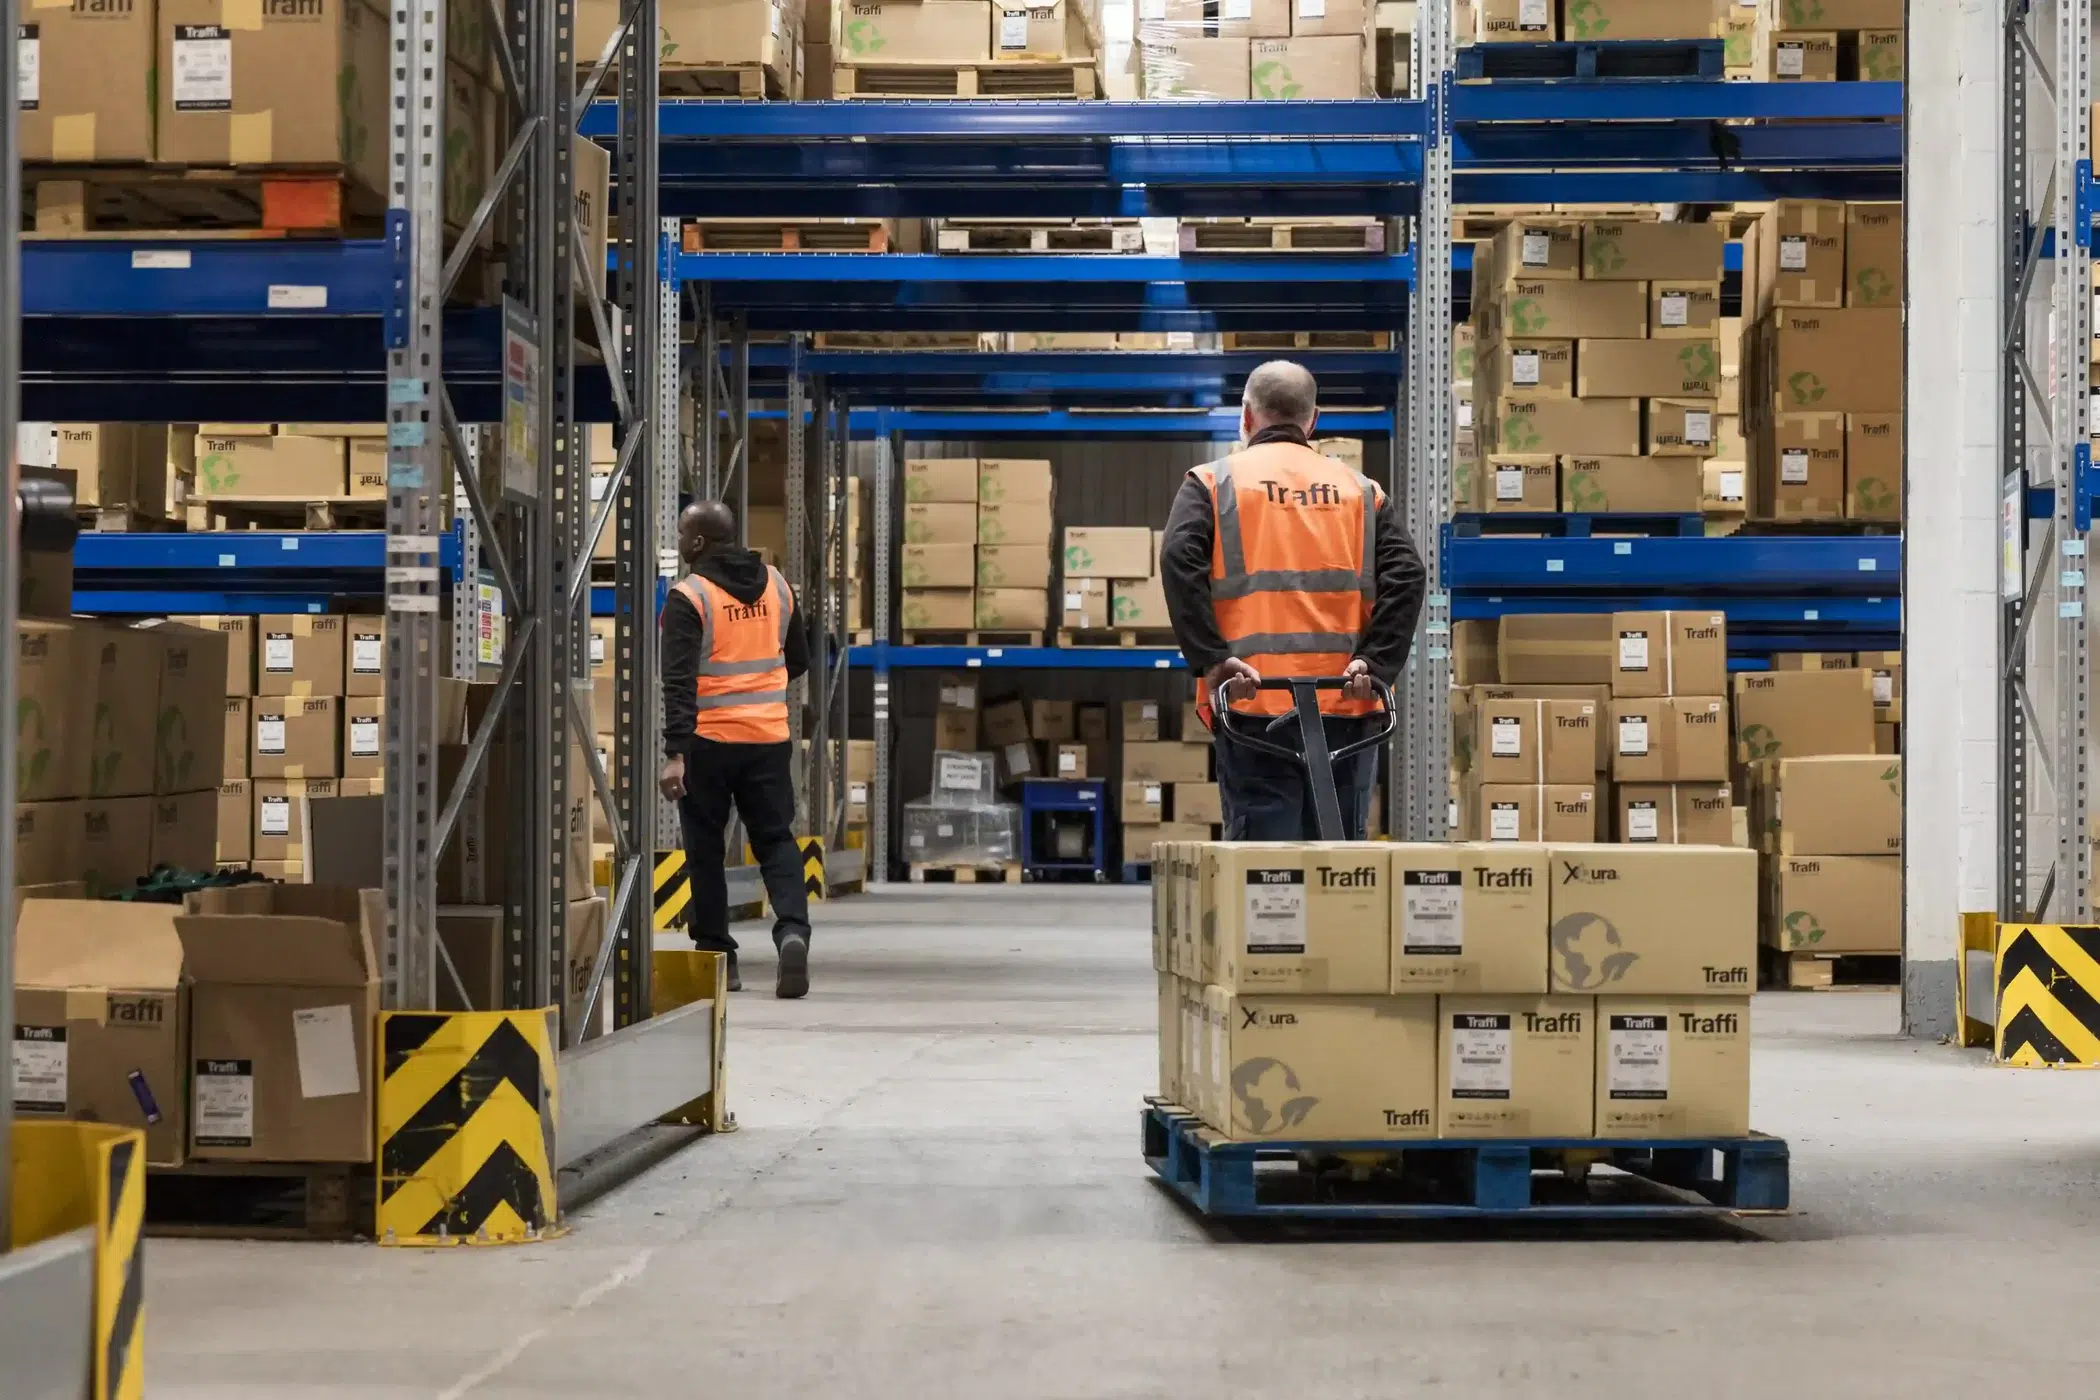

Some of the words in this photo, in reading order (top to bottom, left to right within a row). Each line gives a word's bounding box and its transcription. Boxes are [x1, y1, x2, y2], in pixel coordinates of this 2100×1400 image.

[853, 5, 881, 15] Traffi
[185, 27, 218, 38] Traffi
[1517, 285, 1544, 295] Traffi
[1540, 350, 1568, 360] Traffi
[1508, 403, 1536, 413] Traffi
[63, 429, 92, 441] Traffi
[1861, 424, 1890, 434] Traffi
[207, 440, 236, 451] Traffi
[1524, 465, 1551, 475] Traffi
[1572, 460, 1600, 470] Traffi
[1259, 480, 1340, 506] Traffi
[723, 600, 767, 622] Traffi
[219, 619, 243, 631] raffi
[312, 618, 337, 630] raffi
[1685, 627, 1718, 639] Traffi
[1821, 657, 1846, 669] raffi
[1745, 678, 1774, 688] Traffi
[303, 700, 327, 711] raffi
[1556, 716, 1589, 728] Traffi
[1684, 712, 1717, 724] Traffi
[218, 782, 243, 794] raffi
[1555, 801, 1588, 813] Traffi
[1691, 798, 1724, 810] Traffi
[571, 798, 584, 832] affi
[1789, 861, 1820, 872] Traffi
[1261, 871, 1291, 883] Traffi
[1316, 867, 1376, 887] Traffi
[1417, 872, 1448, 884] Traffi
[1473, 867, 1532, 887] Traffi
[1702, 966, 1748, 983] Traffi
[1466, 1016, 1497, 1028] Traffi
[1522, 1012, 1581, 1033] Traffi
[1623, 1017, 1655, 1028] Traffi
[1679, 1012, 1738, 1033] Traffi
[22, 1026, 53, 1039] Traffi
[207, 1061, 239, 1072] Traffi
[1383, 1109, 1429, 1126] Traffi
